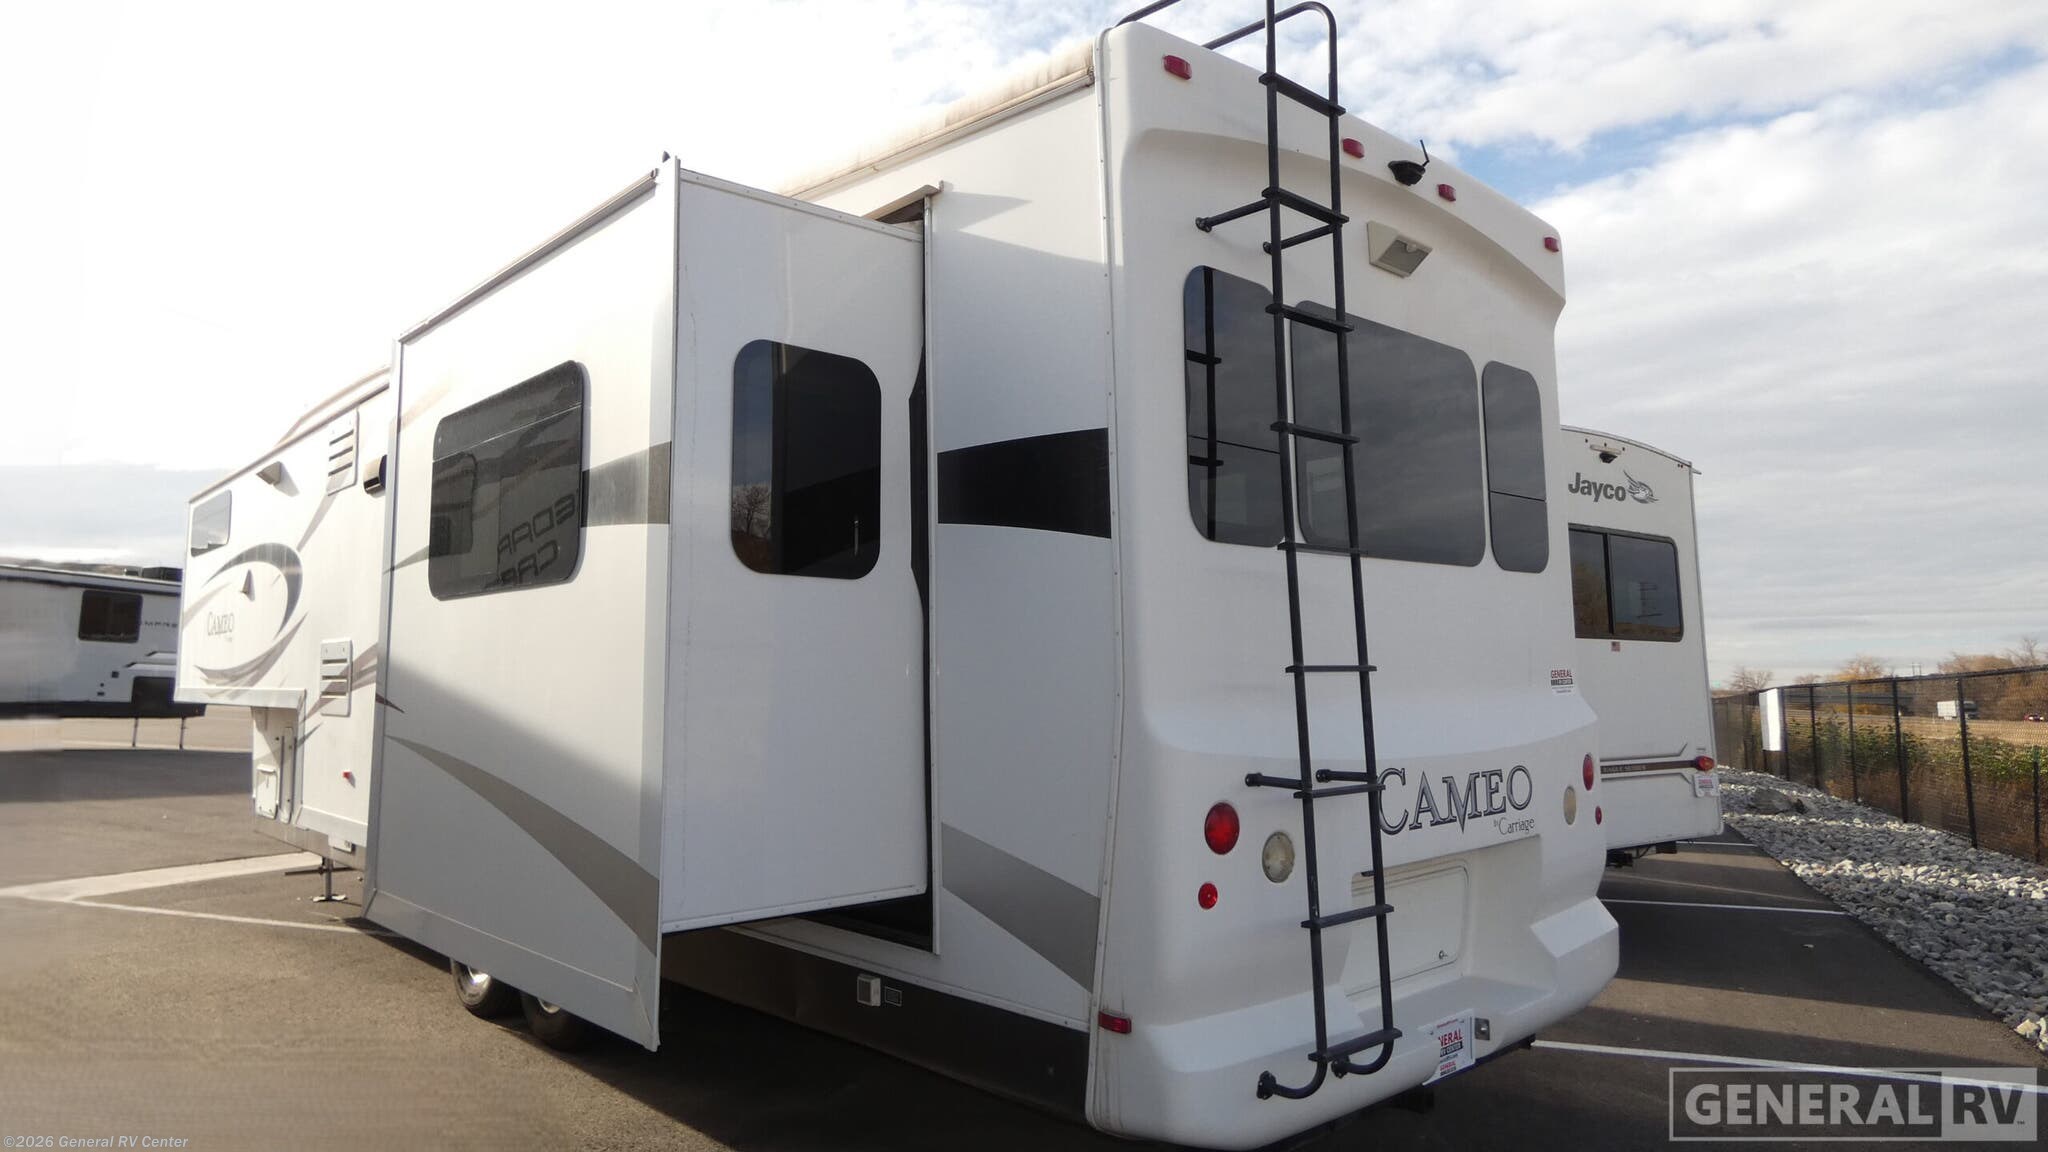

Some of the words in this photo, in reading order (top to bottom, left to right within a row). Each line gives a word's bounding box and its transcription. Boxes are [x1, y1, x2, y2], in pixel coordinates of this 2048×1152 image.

[1568, 472, 1627, 502] Jayco
[1377, 764, 1533, 836] CAMEO
[1499, 817, 1535, 835] Carriage
